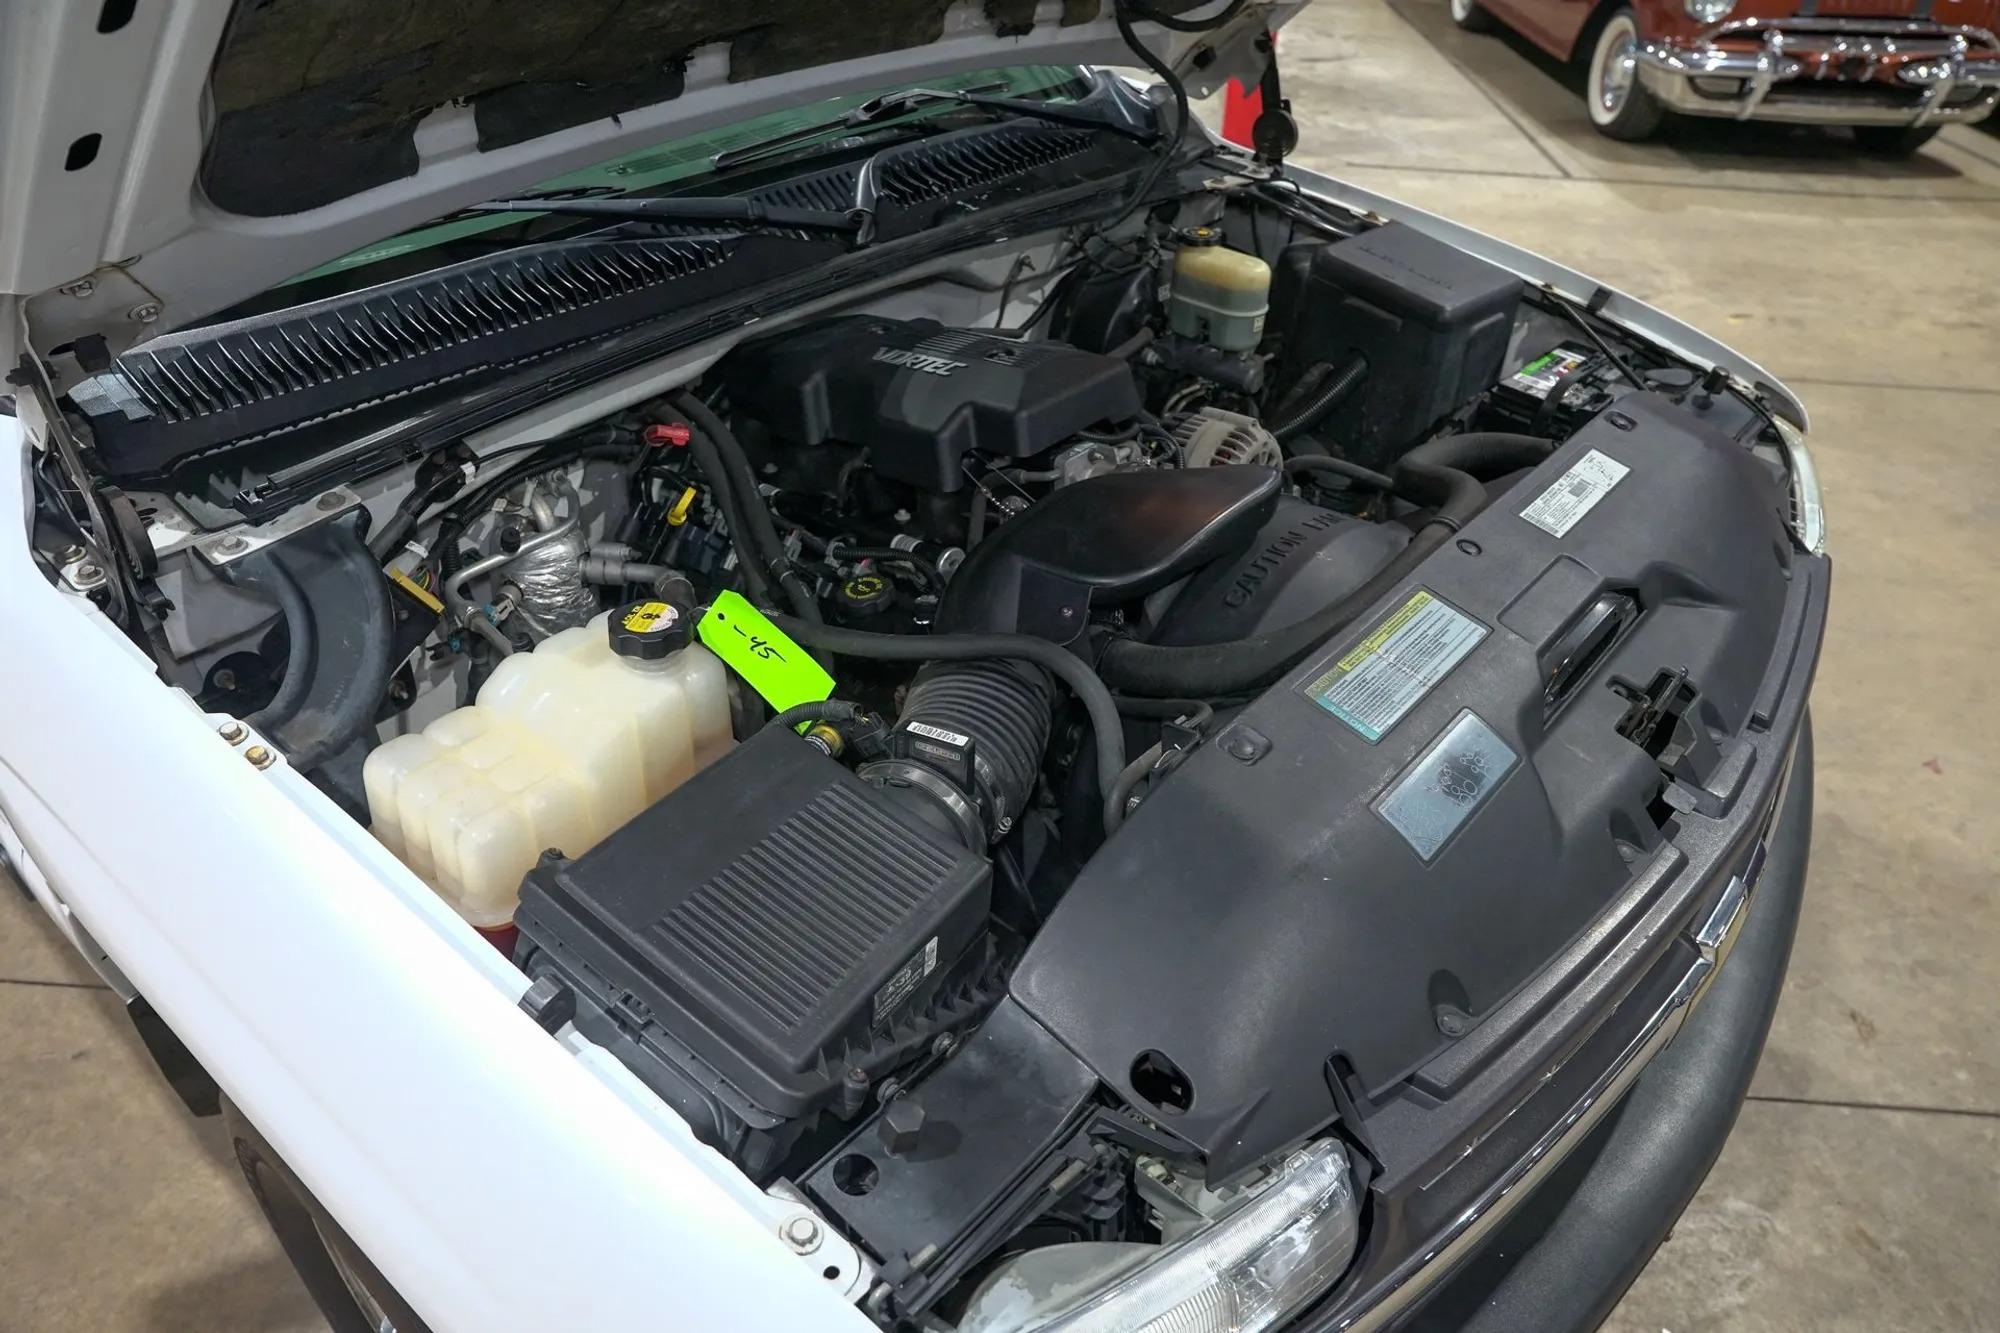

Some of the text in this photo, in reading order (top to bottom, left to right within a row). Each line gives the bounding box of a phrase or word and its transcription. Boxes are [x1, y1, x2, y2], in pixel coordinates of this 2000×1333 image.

[872, 346, 968, 376] VORTEC
[1223, 530, 1308, 608] CAUTION
[1329, 704, 1366, 732] NOTICE
